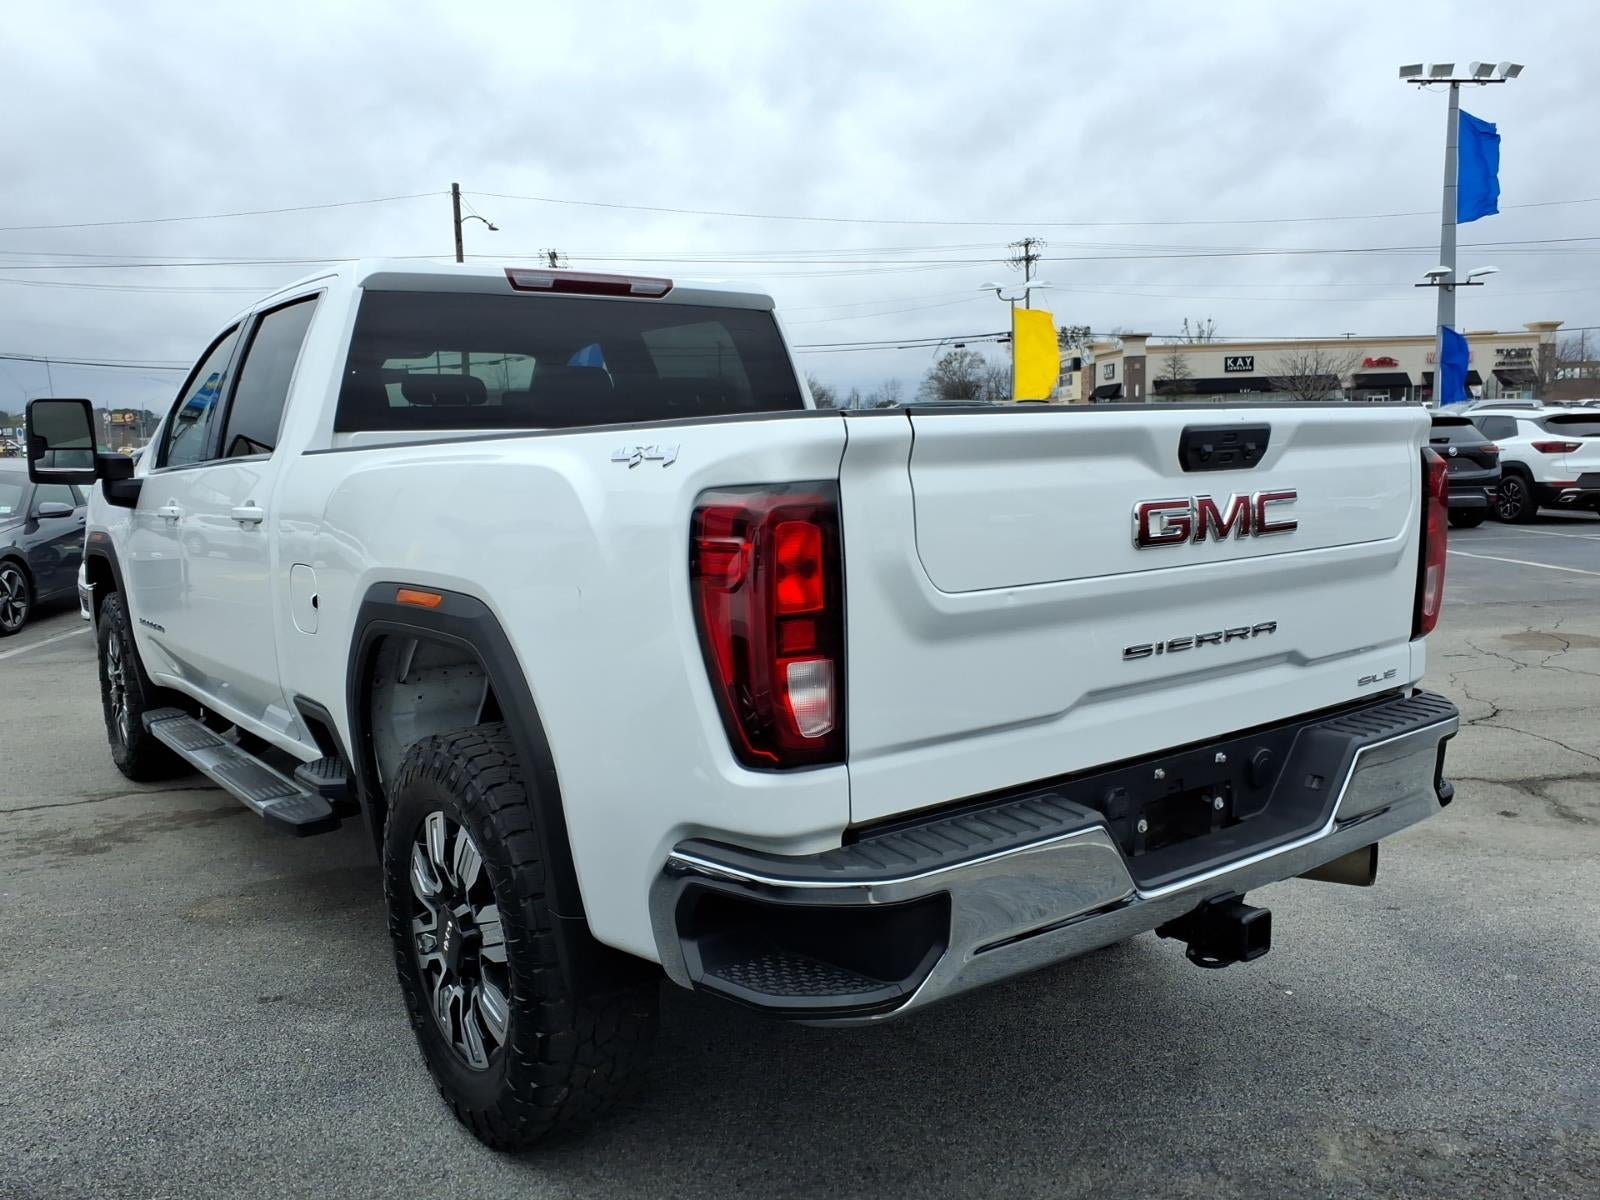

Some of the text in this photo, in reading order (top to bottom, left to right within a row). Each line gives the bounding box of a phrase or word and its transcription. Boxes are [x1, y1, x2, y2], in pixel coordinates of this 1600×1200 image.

[1227, 357, 1252, 367] KAY
[610, 442, 681, 469] 4X4
[1131, 488, 1298, 550] GMC
[1122, 620, 1277, 661] SIERRA
[1357, 668, 1398, 687] SLE
